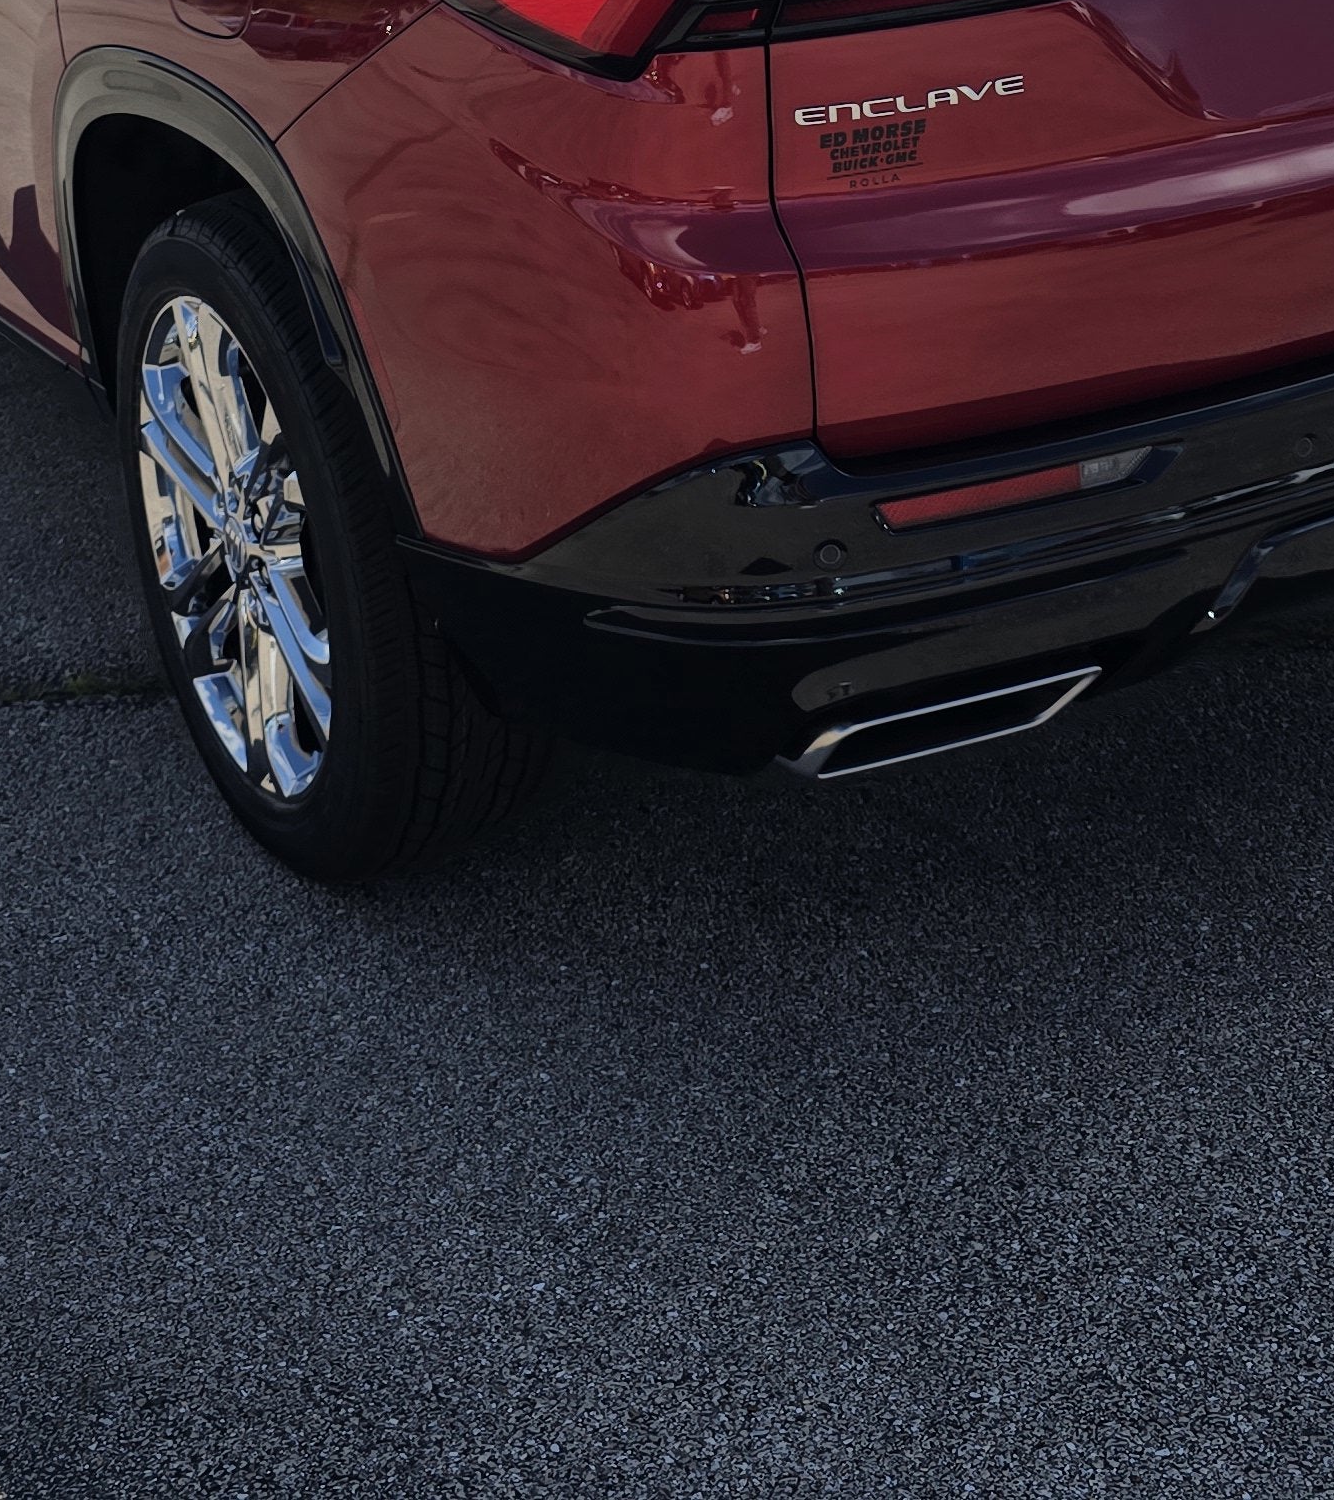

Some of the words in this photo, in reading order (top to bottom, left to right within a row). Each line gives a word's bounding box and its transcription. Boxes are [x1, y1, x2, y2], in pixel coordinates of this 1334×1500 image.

[794, 75, 1025, 126] ENCLAVE
[820, 132, 847, 149] ED
[852, 118, 927, 145] MORSE
[830, 136, 921, 161] CHEVROLET
[885, 150, 918, 166] GMC
[849, 173, 902, 189] ROLLA
